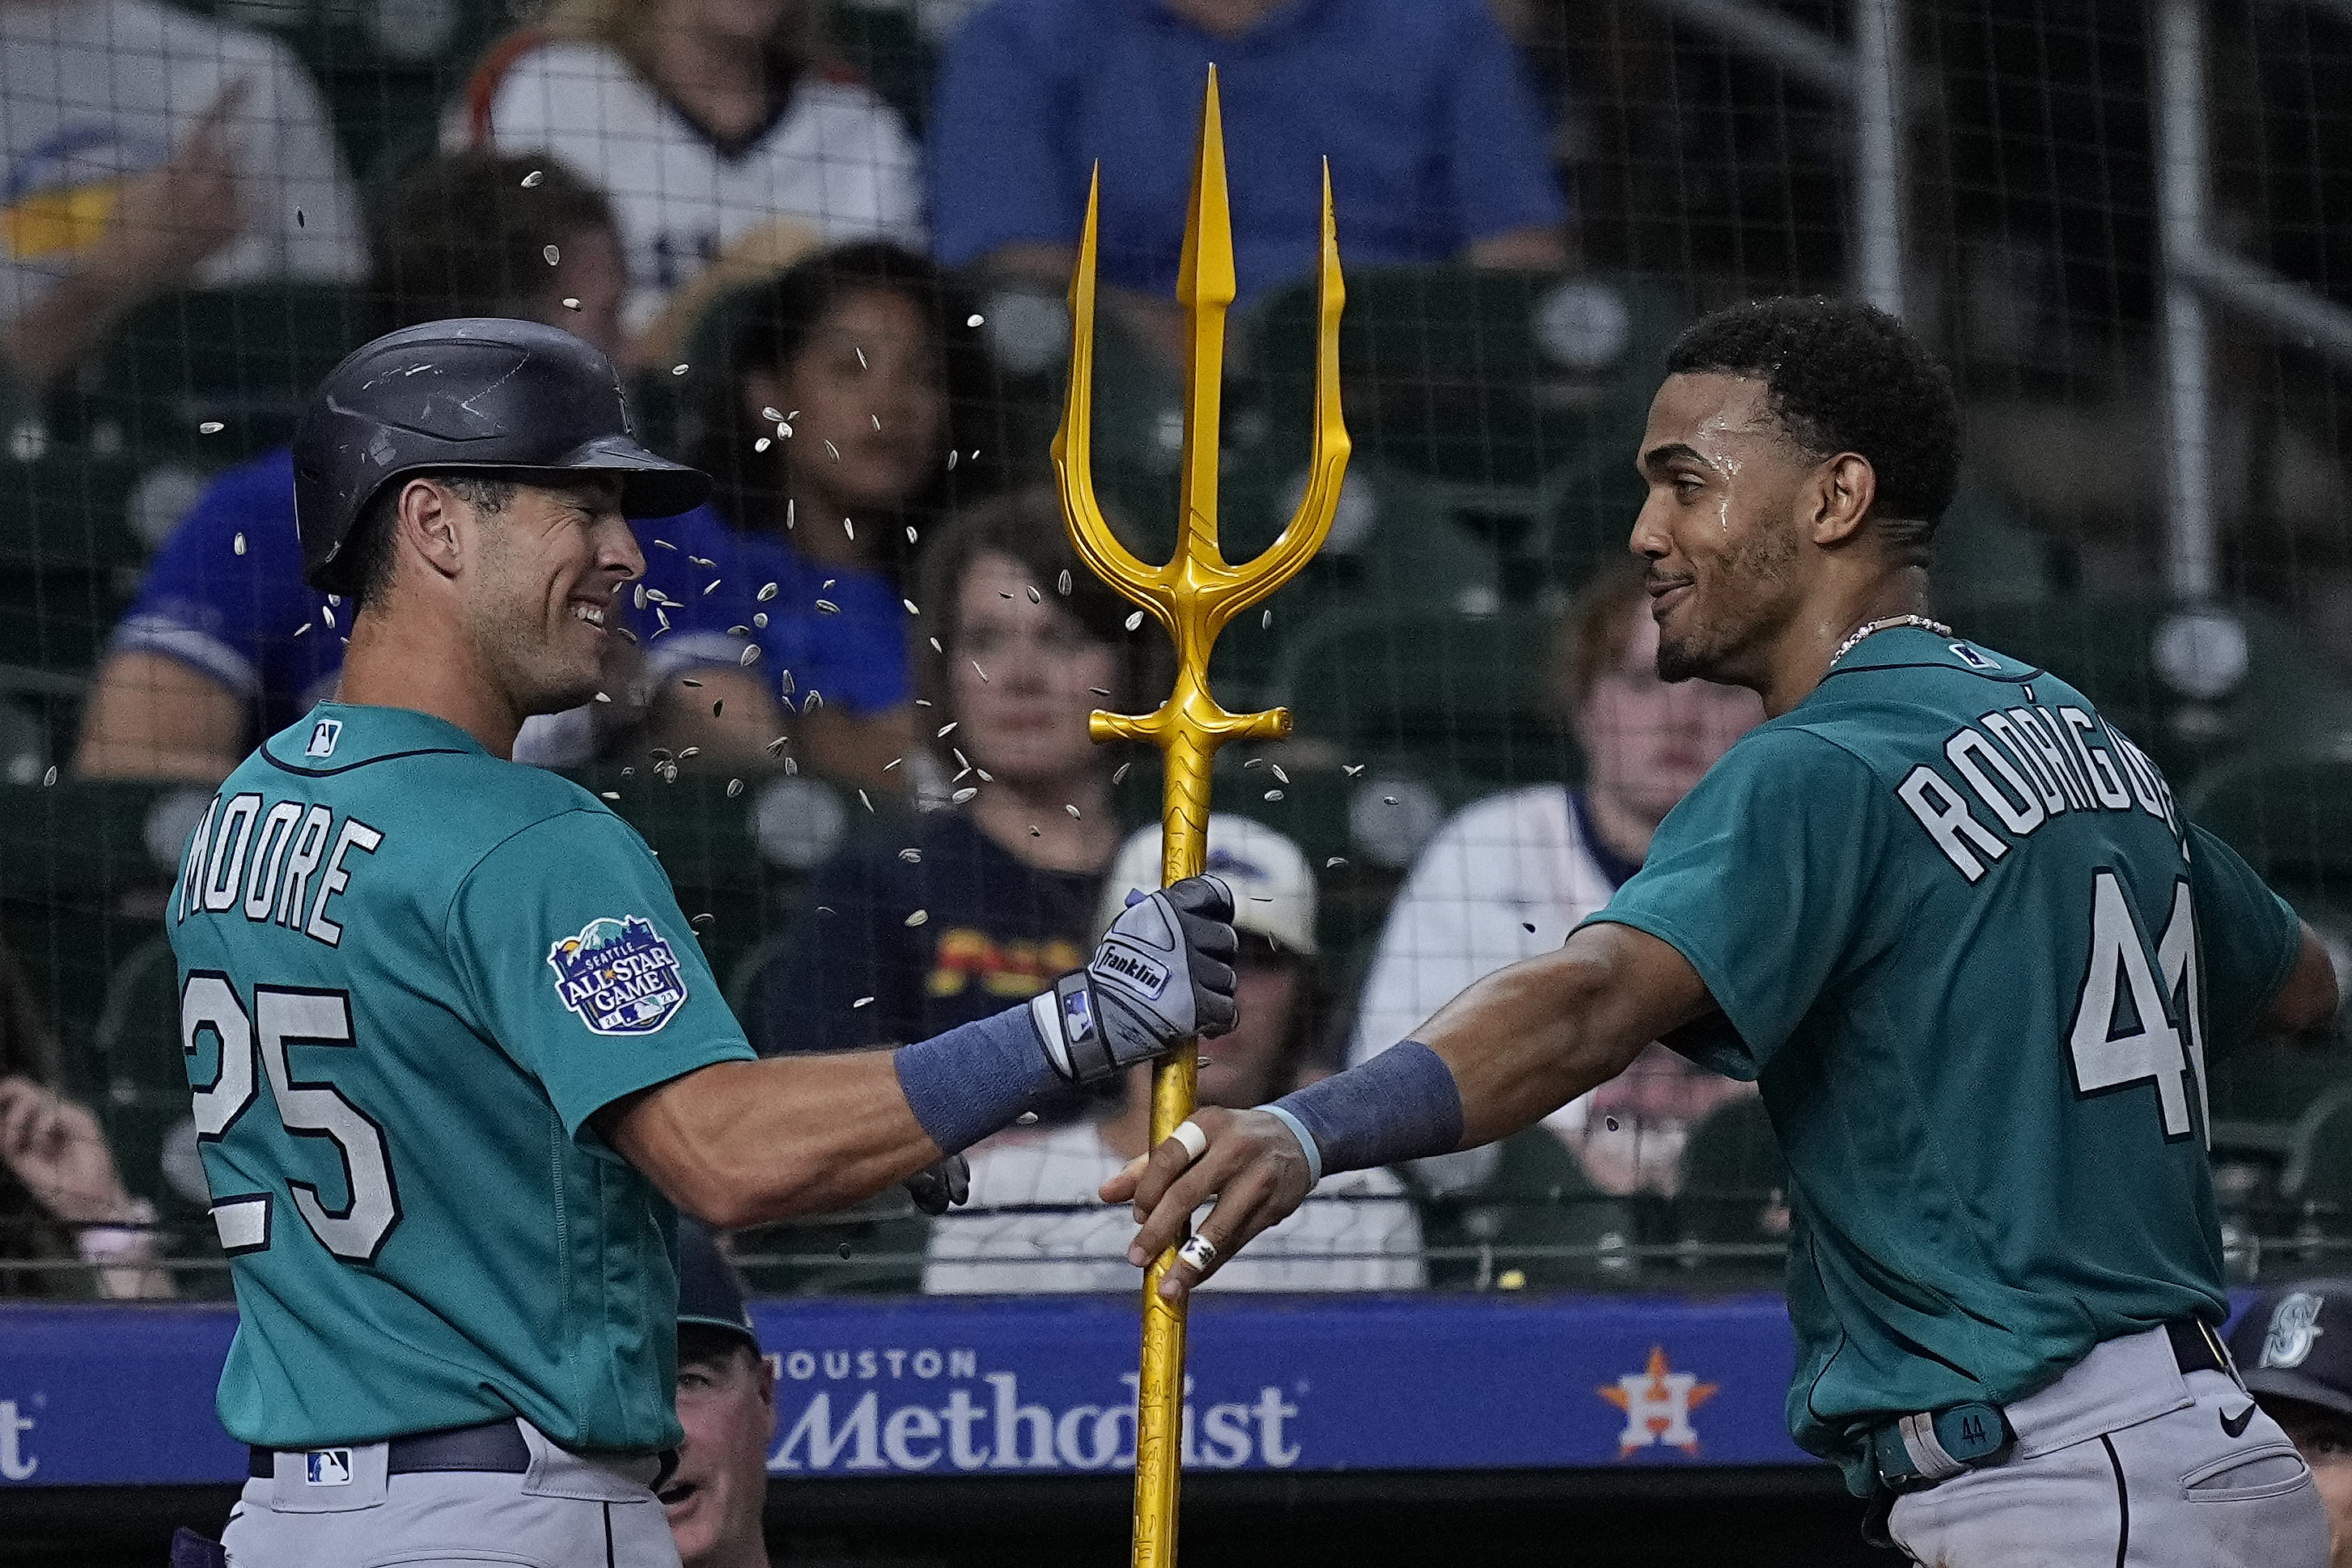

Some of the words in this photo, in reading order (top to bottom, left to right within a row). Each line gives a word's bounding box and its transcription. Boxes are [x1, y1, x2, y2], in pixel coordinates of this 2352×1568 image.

[177, 792, 386, 950] MOORE
[566, 969, 615, 1005] ALL
[612, 947, 674, 981] STAR
[585, 942, 635, 971] SEATTLE
[595, 971, 665, 1011] GAME
[180, 968, 404, 1268] 25
[1961, 1414, 1990, 1446] 44
